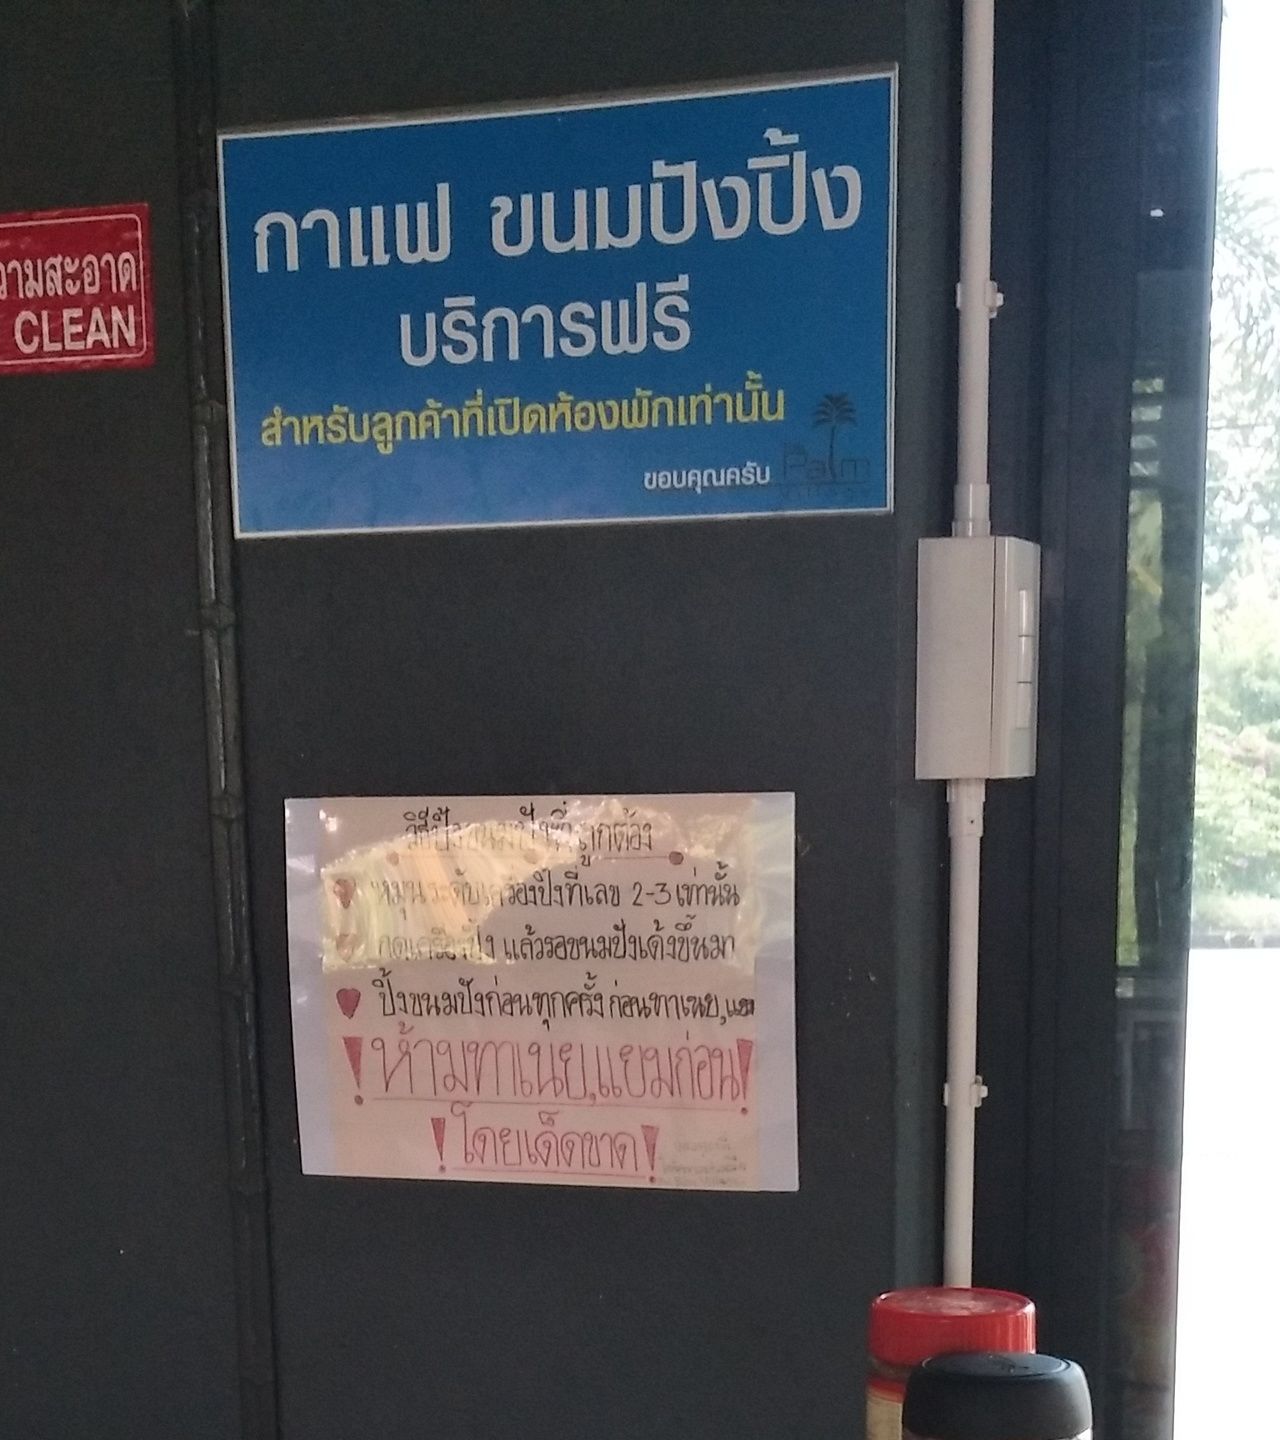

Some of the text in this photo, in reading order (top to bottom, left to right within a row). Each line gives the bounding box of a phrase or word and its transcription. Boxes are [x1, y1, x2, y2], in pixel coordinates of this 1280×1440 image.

[254, 127, 863, 274] กาแฟ ขนมปังปิ้ง
[14, 304, 137, 355] CLEAN
[399, 274, 692, 367] บริการฟรี
[260, 370, 785, 455] สำหรับลูกค้าที่เปิดห้องพักเท่านั้น
[643, 461, 771, 494] ขอบคุณครับ
